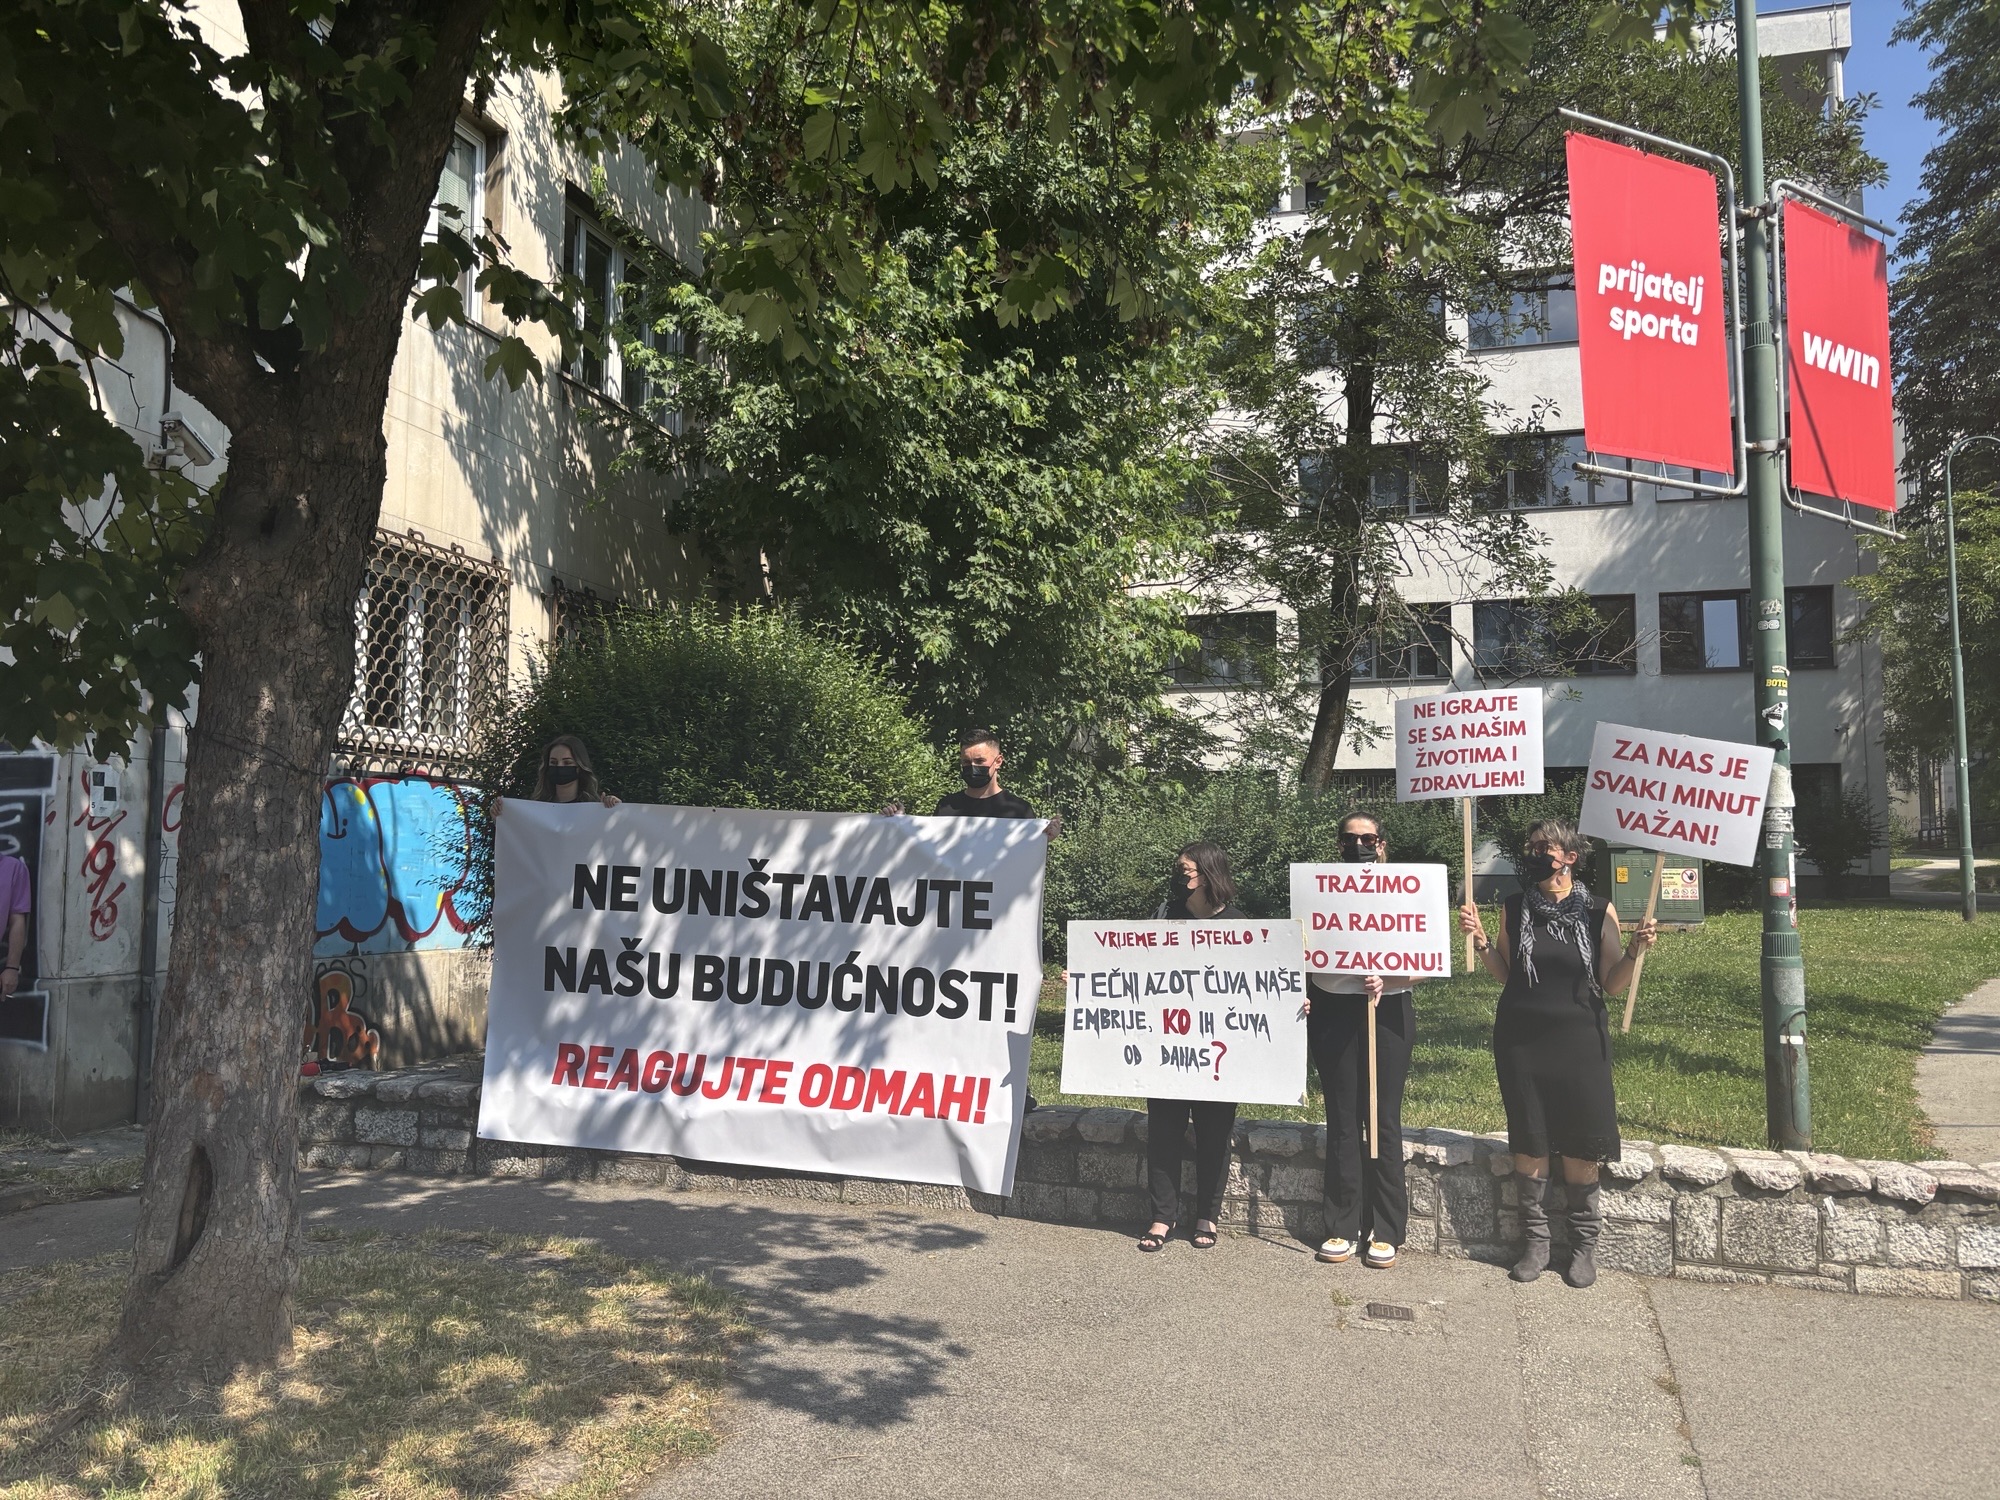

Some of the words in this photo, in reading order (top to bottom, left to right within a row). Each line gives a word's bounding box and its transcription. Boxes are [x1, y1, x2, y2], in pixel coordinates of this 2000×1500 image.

[1598, 259, 1705, 315] prijatelj
[1608, 306, 1699, 347] sporta
[1414, 702, 1436, 719] NE
[1441, 696, 1518, 716] IGRAJTE
[1408, 727, 1427, 744] SE
[1431, 725, 1456, 742] SA
[1461, 716, 1526, 739] NAŠIM
[1415, 747, 1507, 768] ŽIVOTIMA
[1512, 745, 1517, 761] I
[1612, 739, 1649, 765] ZA
[1656, 746, 1715, 774] NAS
[1719, 757, 1749, 780] JE
[1410, 770, 1525, 794] ZDRAVLJEM!
[1591, 770, 1667, 802] SVAKI
[1671, 784, 1761, 817] MINUT
[1616, 808, 1719, 846] VAŽAN!
[572, 863, 641, 913] NE
[651, 858, 993, 930] UNIŠTAVAJTE
[1315, 869, 1421, 893] TRAŽIMO
[1094, 931, 1157, 950] VRIJEME
[1162, 931, 1179, 946] JE
[1191, 929, 1254, 950] ISTEKLO
[1312, 912, 1343, 931] DA
[1349, 913, 1426, 932] RADITE
[1335, 950, 1443, 972] ZAKONU!
[544, 937, 681, 1000] NAŠU
[692, 951, 1018, 1023] BUDUĆNOST!
[1144, 969, 1200, 1001] AZOT
[1203, 964, 1252, 1003] ČUVA
[1255, 966, 1302, 1001] NAŠE
[1162, 1008, 1191, 1035] KO
[1199, 1010, 1215, 1039] IH
[1224, 1006, 1272, 1042] ČUVA
[1124, 1044, 1142, 1066] OD
[551, 1043, 794, 1105] REAGUJTE
[799, 1062, 992, 1125] ODMAH!
